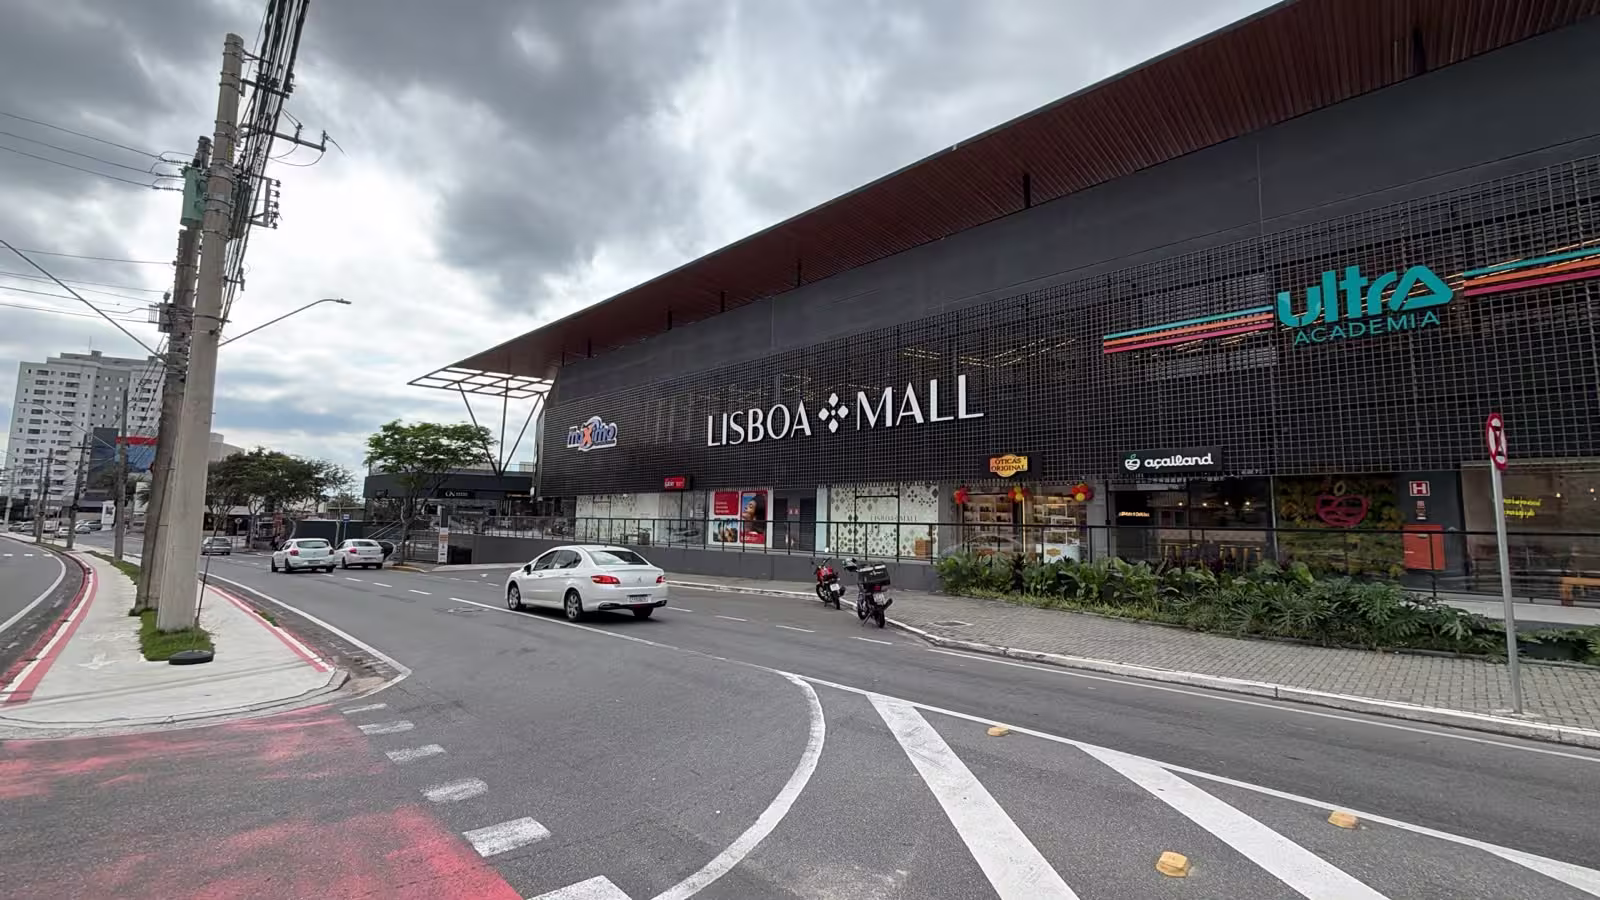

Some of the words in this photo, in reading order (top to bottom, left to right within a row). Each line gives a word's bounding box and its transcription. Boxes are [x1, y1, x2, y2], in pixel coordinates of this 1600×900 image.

[1294, 310, 1441, 345] ACADEMIA
[707, 399, 812, 447] LISBOA
[857, 374, 985, 431] MALL
[991, 464, 1025, 472] ORIGINAL
[1144, 452, 1214, 470] açailand
